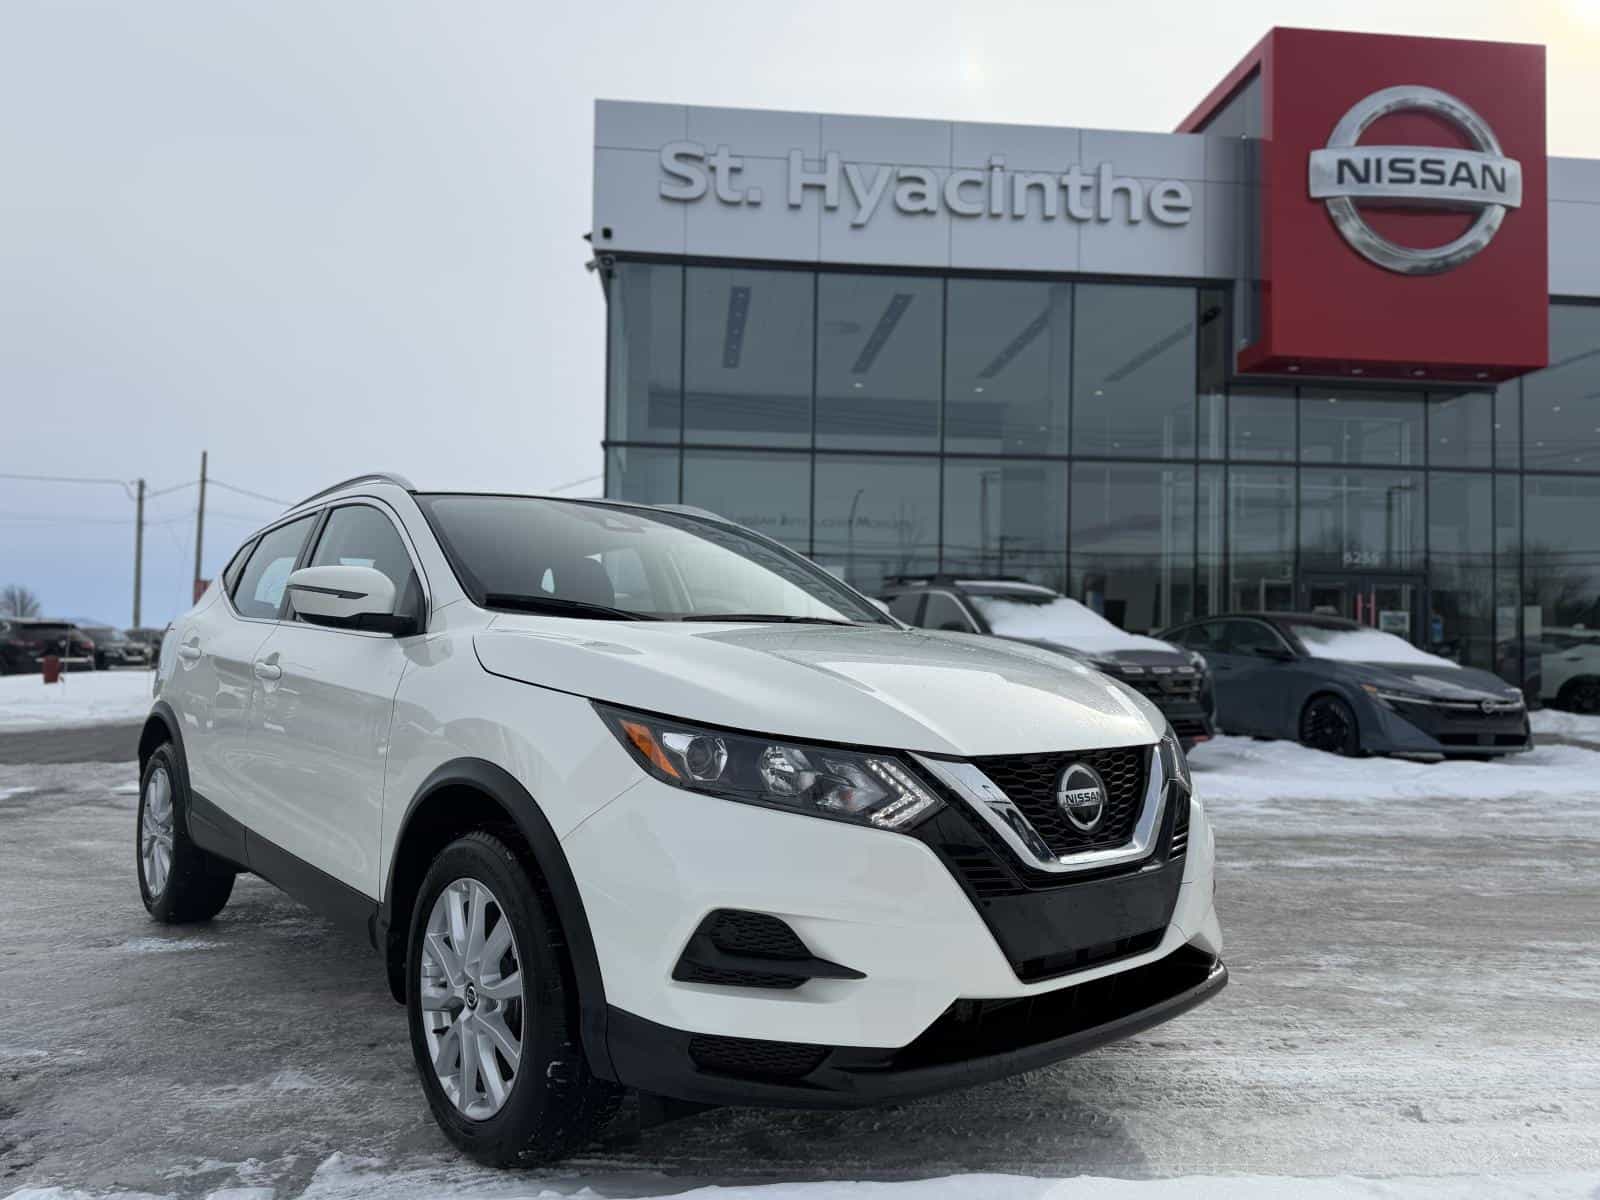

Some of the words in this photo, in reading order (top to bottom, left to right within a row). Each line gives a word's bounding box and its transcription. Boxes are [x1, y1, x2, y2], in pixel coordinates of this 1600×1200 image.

[659, 141, 762, 205] St.
[787, 148, 1193, 228] Hyacinthe
[1336, 156, 1507, 193] NISSAN
